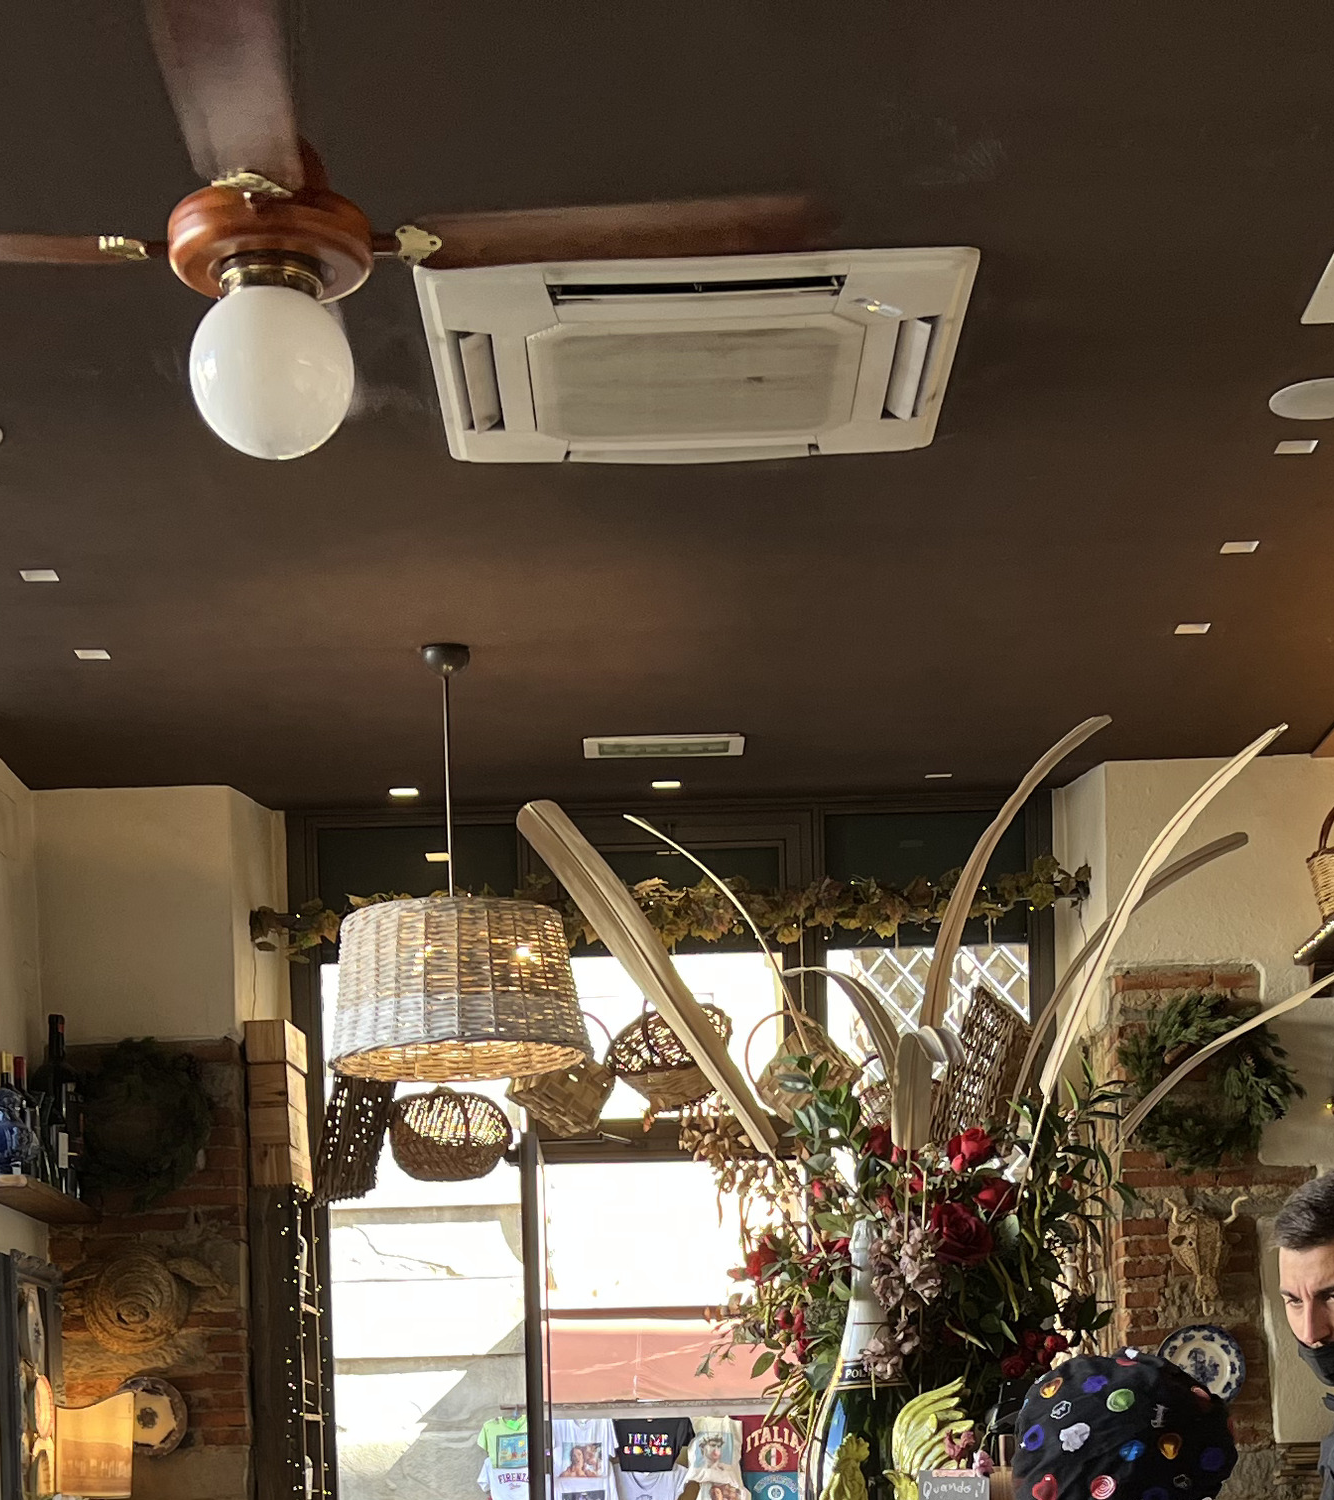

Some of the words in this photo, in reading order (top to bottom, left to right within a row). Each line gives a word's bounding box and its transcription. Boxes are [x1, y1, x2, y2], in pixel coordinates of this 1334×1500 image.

[745, 1425, 803, 1454] ITALIA
[497, 1471, 530, 1485] FIRENZ
[922, 1480, 971, 1500] Quando
